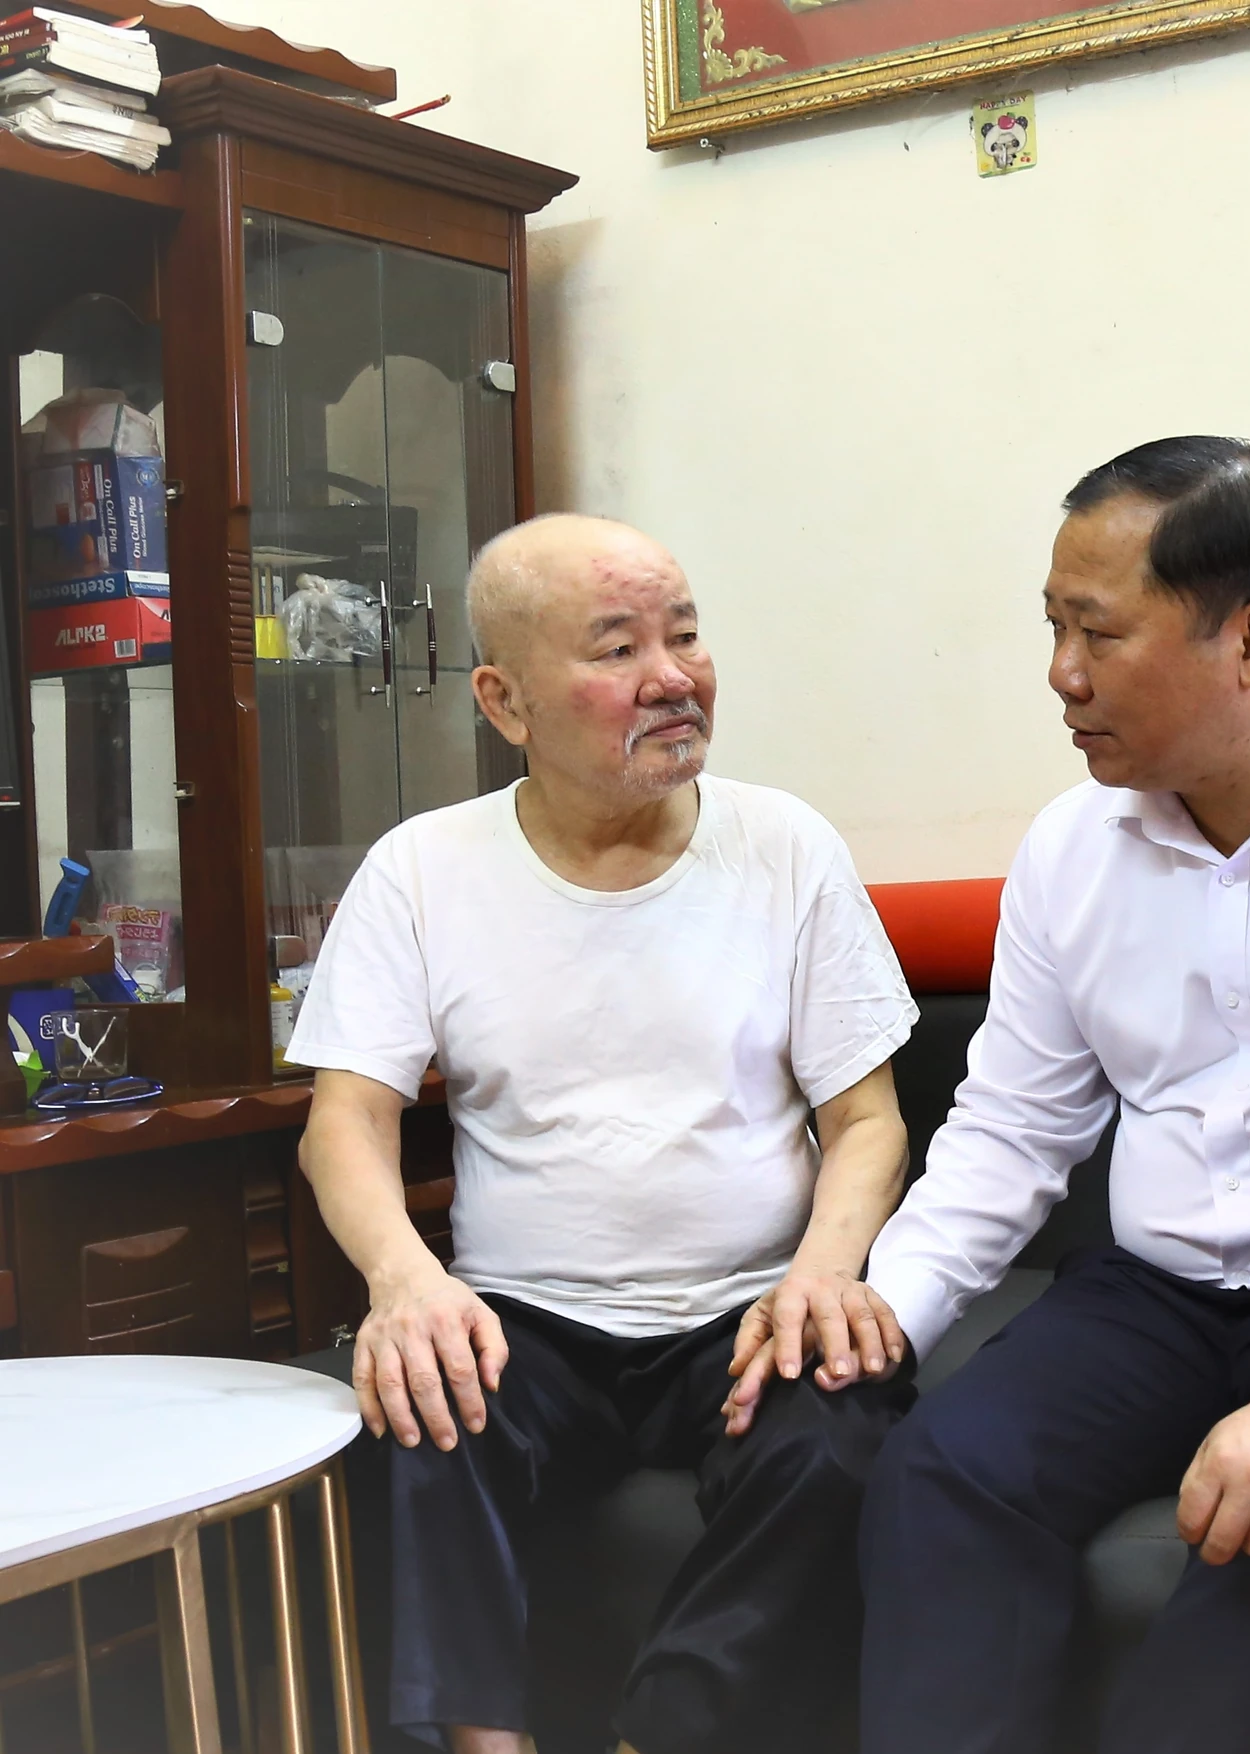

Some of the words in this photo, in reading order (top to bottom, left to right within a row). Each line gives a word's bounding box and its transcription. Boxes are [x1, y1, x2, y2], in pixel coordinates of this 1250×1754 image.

[1009, 95, 1027, 105] DAY
[104, 479, 112, 497] On
[105, 499, 116, 524] Call
[128, 496, 138, 518] Plus
[108, 526, 118, 553] Plus
[130, 520, 140, 541] Call
[133, 542, 141, 558] On
